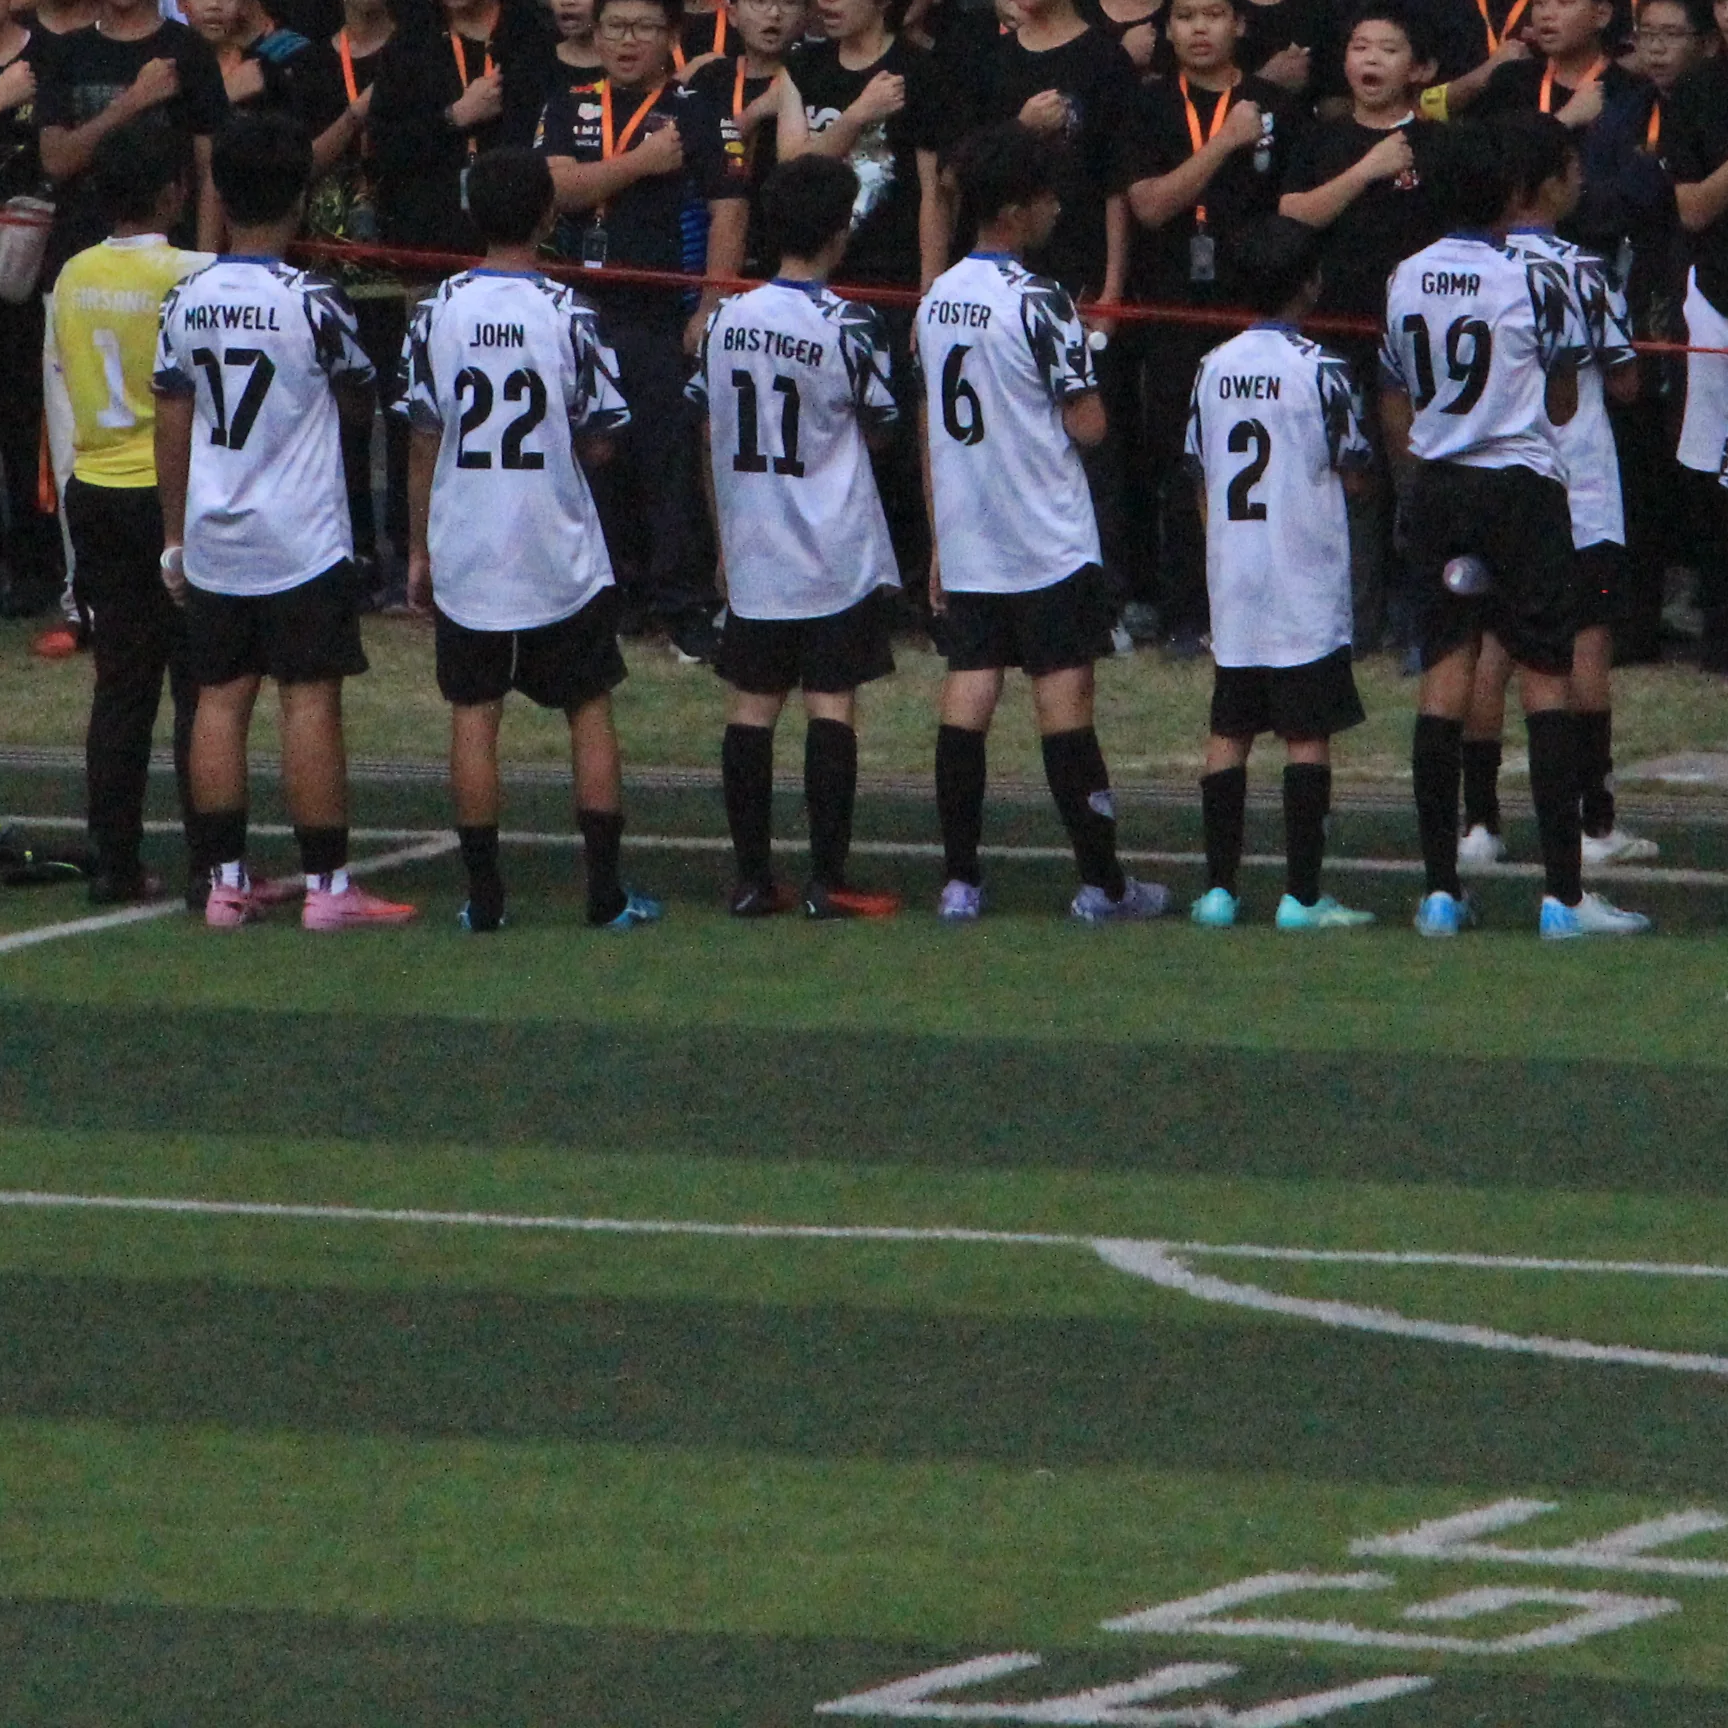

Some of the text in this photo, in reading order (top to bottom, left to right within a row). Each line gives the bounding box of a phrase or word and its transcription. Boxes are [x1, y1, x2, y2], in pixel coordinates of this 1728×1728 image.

[184, 306, 280, 332] MAXWELL
[927, 302, 992, 329] FOSTER
[1421, 272, 1480, 297] GAMA
[93, 328, 136, 428] 1
[469, 325, 524, 348] JOHN
[723, 327, 823, 367] BASTIGER
[1402, 313, 1491, 415] 19
[192, 348, 275, 450] 17
[454, 366, 547, 469] 22
[731, 369, 805, 478] 11
[941, 344, 985, 446] 6
[1219, 375, 1280, 400] OWEN
[1227, 418, 1271, 521] 2
